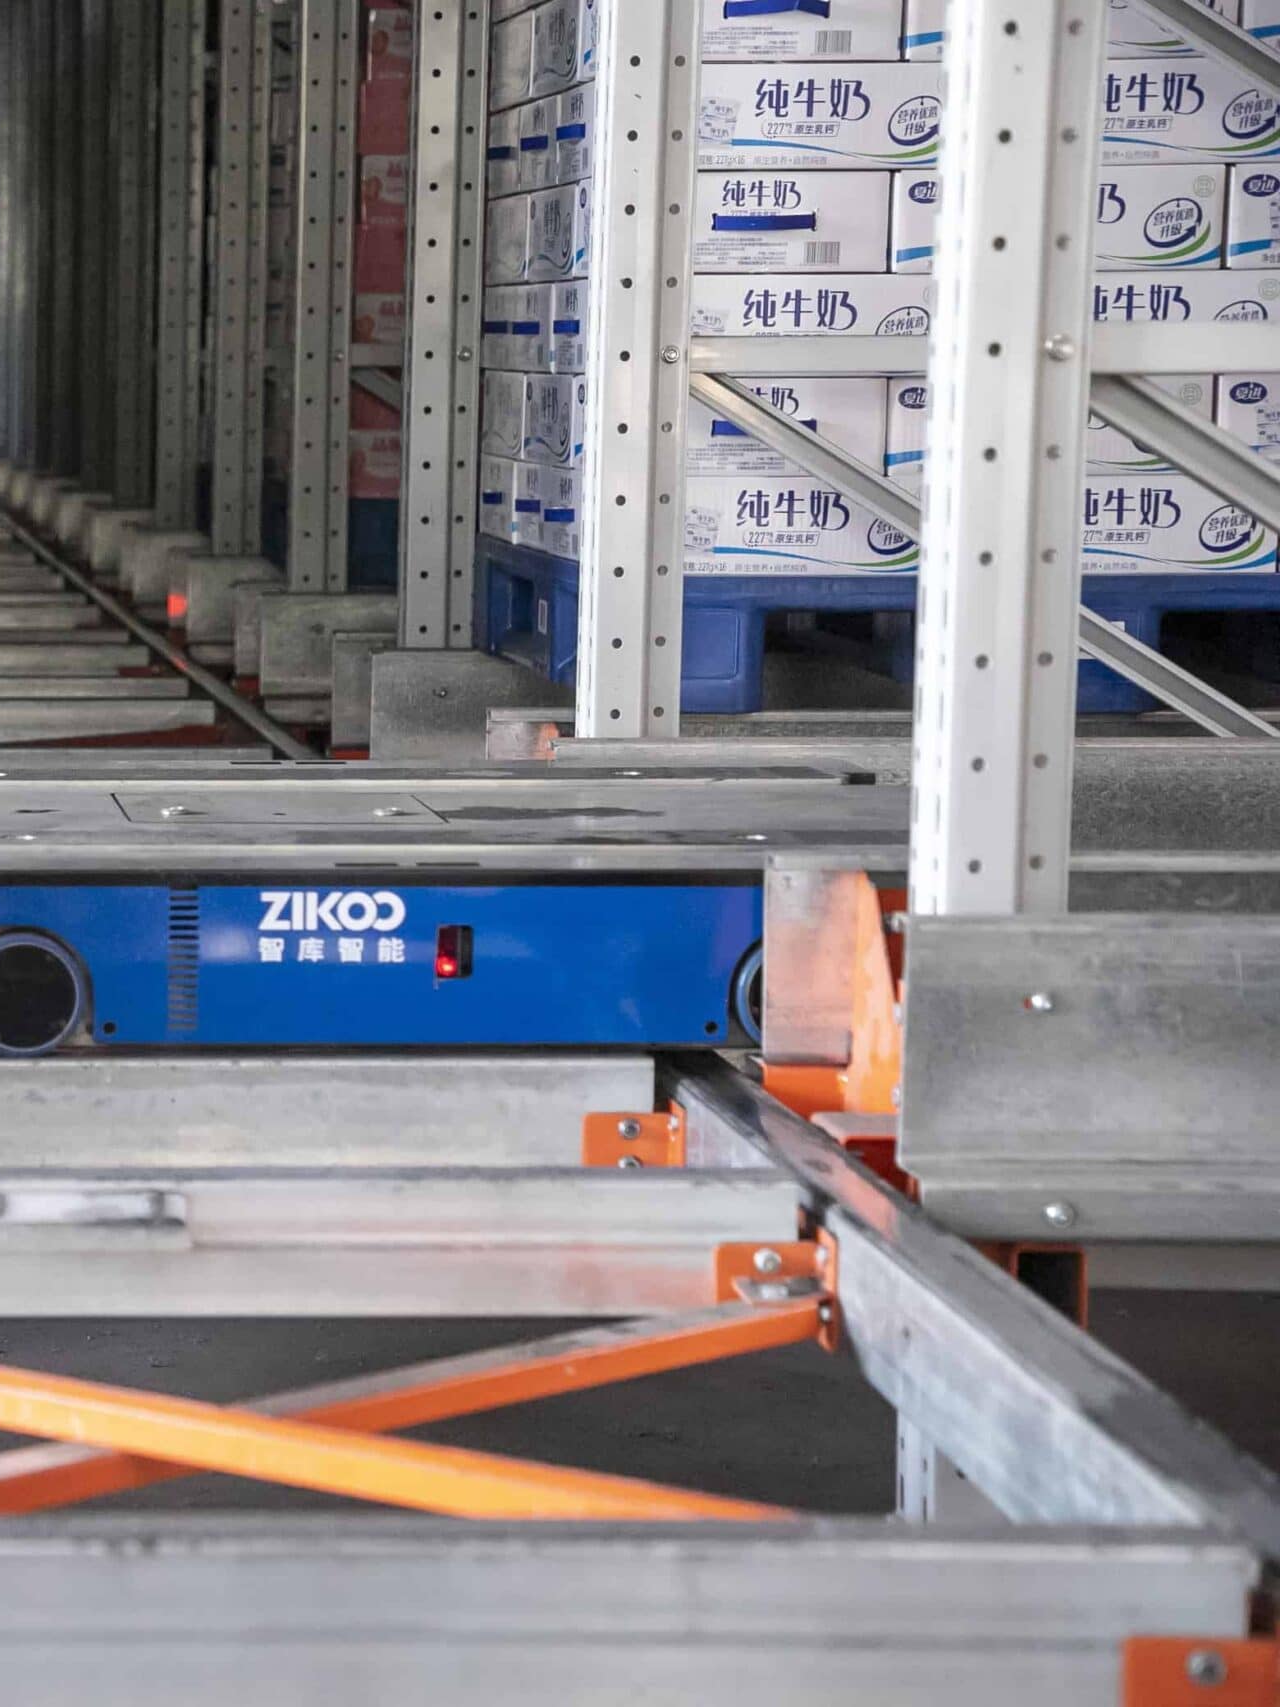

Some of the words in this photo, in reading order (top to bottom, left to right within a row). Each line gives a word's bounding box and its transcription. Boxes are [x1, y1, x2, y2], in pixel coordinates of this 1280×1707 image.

[755, 78, 871, 121] 纯牛奶
[904, 122, 926, 137] 升级
[722, 180, 802, 210] 纯牛奶
[1160, 223, 1183, 238] 升级
[743, 289, 858, 331] 纯牛奶
[736, 489, 851, 532] 纯牛奶
[1215, 529, 1238, 544] 升级
[259, 891, 407, 931] ZIKOO
[258, 936, 406, 963] 智库智能
